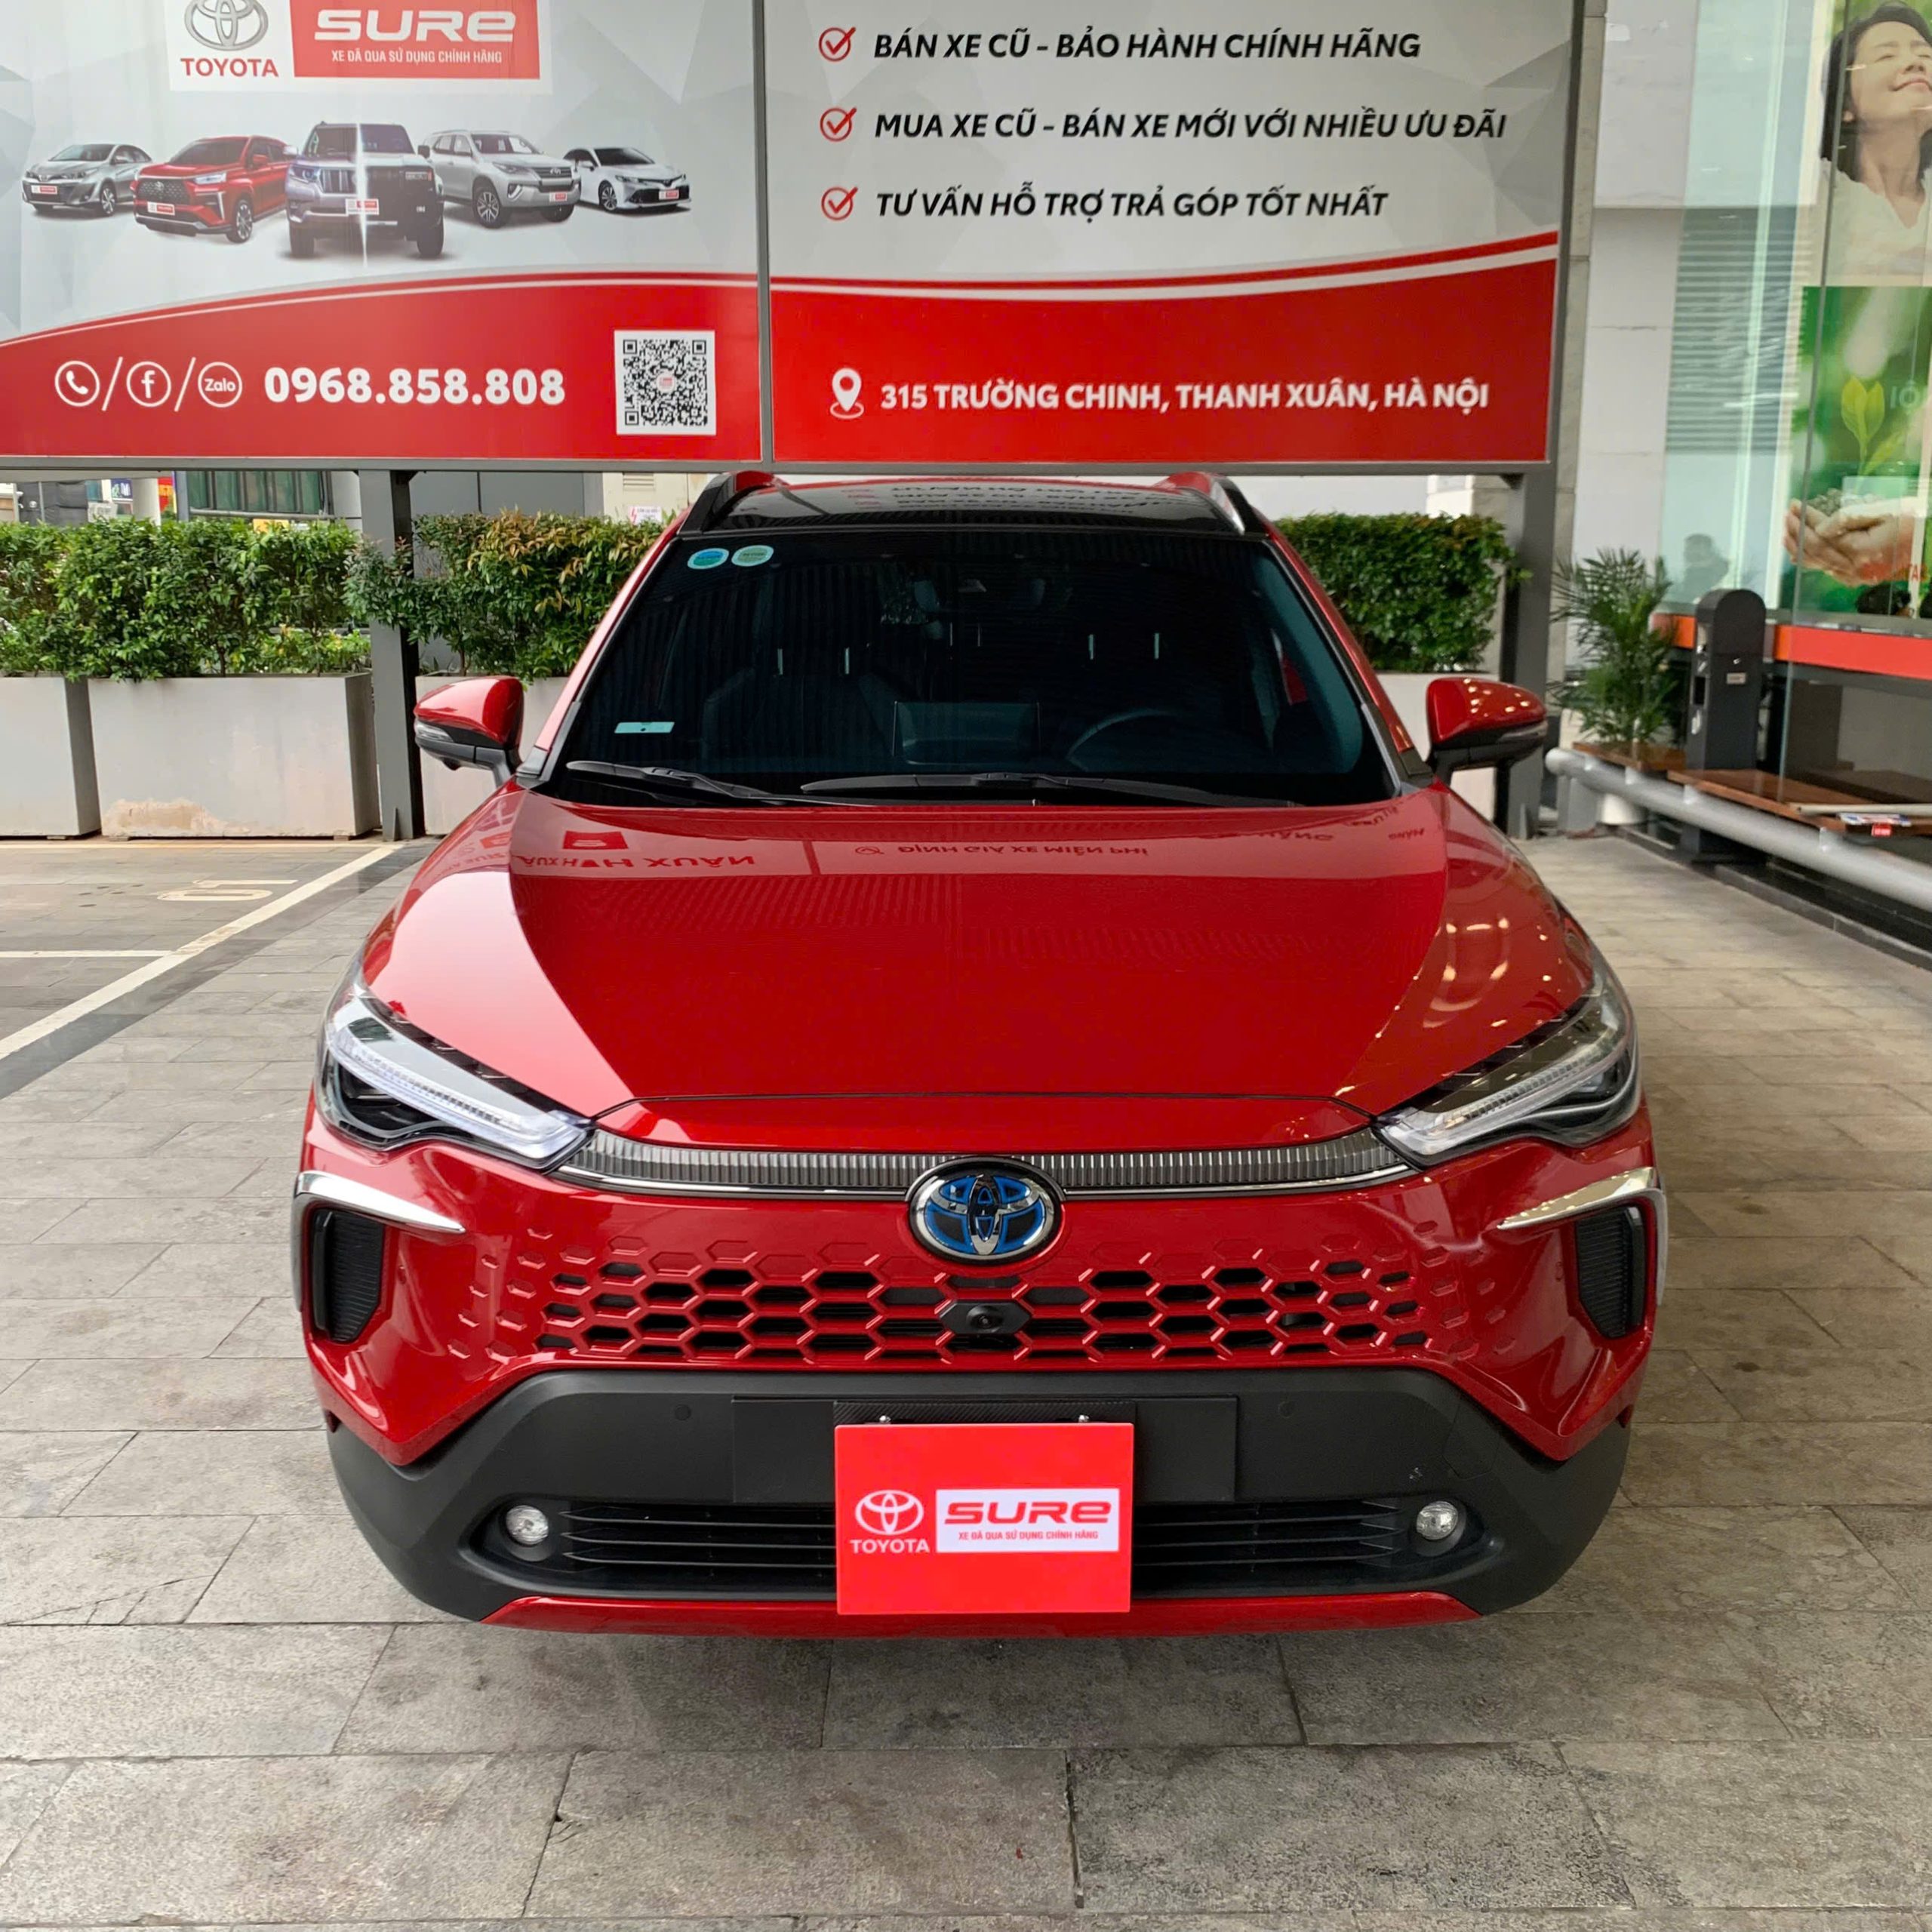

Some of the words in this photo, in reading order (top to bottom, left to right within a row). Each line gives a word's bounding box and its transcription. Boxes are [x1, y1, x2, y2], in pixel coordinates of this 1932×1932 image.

[874, 27, 938, 58] BÁN
[943, 34, 982, 58] XE
[988, 27, 1031, 58] CŨ
[1056, 25, 1120, 58] BẢO
[1126, 27, 1218, 58] HÀNH
[1224, 26, 1324, 58] CHÍNH
[1329, 27, 1421, 58] HÃNG
[180, 57, 278, 77] TOYOTA
[332, 50, 345, 62] XE
[365, 50, 387, 63] QUA
[389, 47, 404, 63] SỬ
[406, 50, 435, 65] DỤNG
[438, 49, 471, 63] CHÍNH
[473, 48, 502, 63] HÃNG
[875, 114, 943, 138] MUA
[949, 114, 989, 137] XE
[995, 107, 1037, 137] CŨ
[1062, 107, 1126, 137] BÁN
[1131, 114, 1170, 137] XE
[1175, 107, 1237, 138] MỚI
[1244, 107, 1297, 138] VỚI
[1303, 106, 1398, 138] NHIỀU
[1404, 109, 1448, 138] ƯU
[1453, 108, 1507, 139] ĐÃI
[877, 190, 917, 217] TƯ
[921, 184, 983, 217] VẤN
[990, 181, 1036, 216] HỖ
[1044, 188, 1104, 223] TRỢ
[1111, 185, 1164, 217] TRẢ
[1174, 186, 1238, 217] GÓP
[1246, 184, 1302, 217] TỐT
[1306, 186, 1389, 217] NHẤT
[204, 378, 236, 392] Zalo
[264, 366, 565, 405] 0968.858.808
[881, 385, 928, 409] 315
[934, 378, 1059, 408] TRƯỜNG
[1065, 384, 1169, 413] CHINH,
[1176, 384, 1280, 408] THANH
[1286, 377, 1377, 411] XUÂN,
[1385, 377, 1426, 407] HÀ
[1433, 377, 1489, 414] NỘI
[850, 1539, 931, 1554] TOYOTA
[958, 1531, 968, 1540] XE
[985, 1531, 1003, 1540] QUA
[1045, 1530, 1072, 1540] CHÍNH
